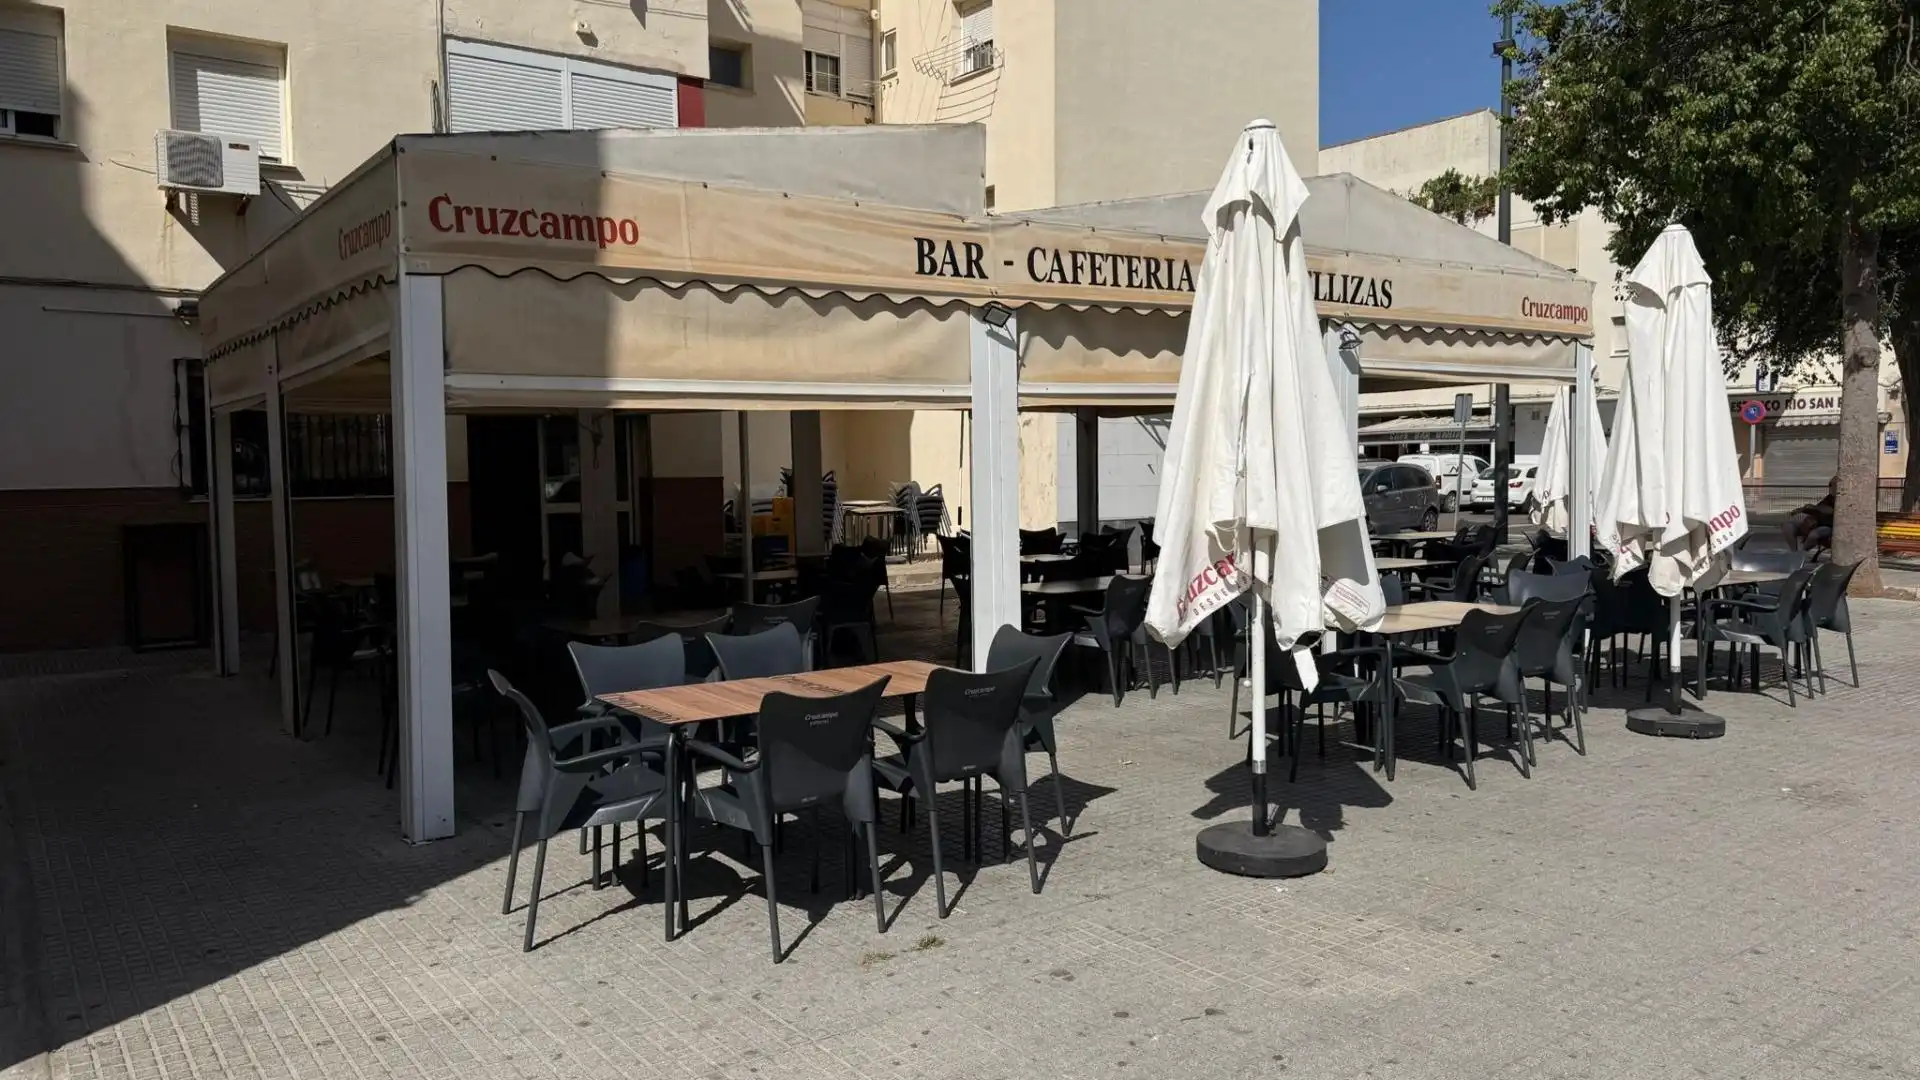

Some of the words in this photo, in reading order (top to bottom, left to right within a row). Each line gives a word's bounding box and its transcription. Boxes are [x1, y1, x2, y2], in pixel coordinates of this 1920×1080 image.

[338, 209, 391, 261] Cruzcampo
[428, 193, 640, 249] Cruzcampo
[914, 237, 989, 280] BAR
[1027, 247, 1197, 292] CAFETERIA
[1307, 270, 1393, 310] LLIZAS
[1521, 295, 1589, 325] Cruzcampo
[1809, 397, 1834, 410] SAN
